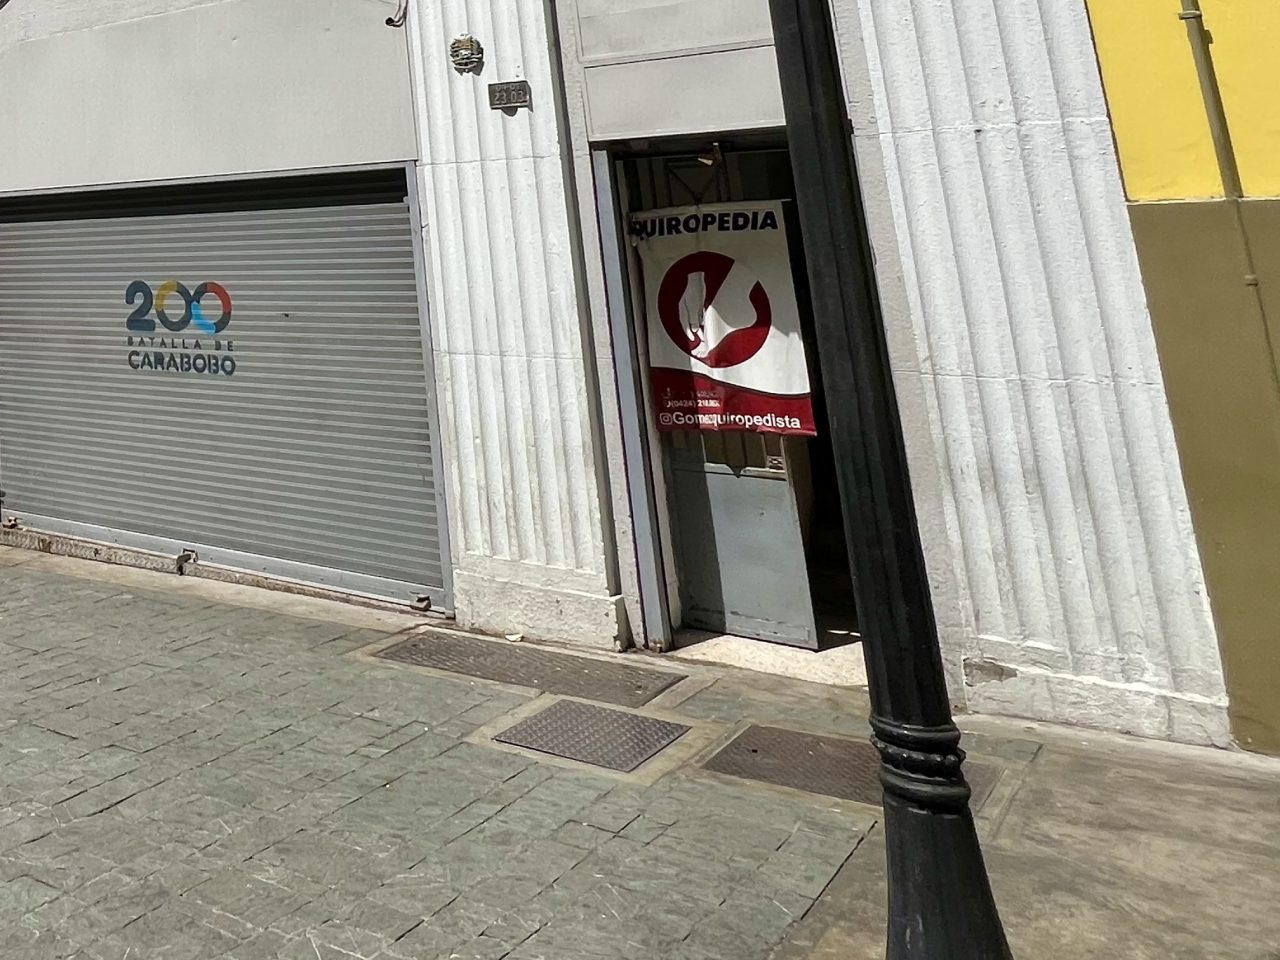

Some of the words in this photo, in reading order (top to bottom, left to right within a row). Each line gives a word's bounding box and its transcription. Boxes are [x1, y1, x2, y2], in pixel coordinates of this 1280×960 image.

[629, 211, 778, 240] QUIROPEDIA
[126, 280, 232, 333] 200
[127, 336, 201, 349] BATALLA
[215, 340, 234, 351] DE
[128, 350, 236, 375] CARABOBO
